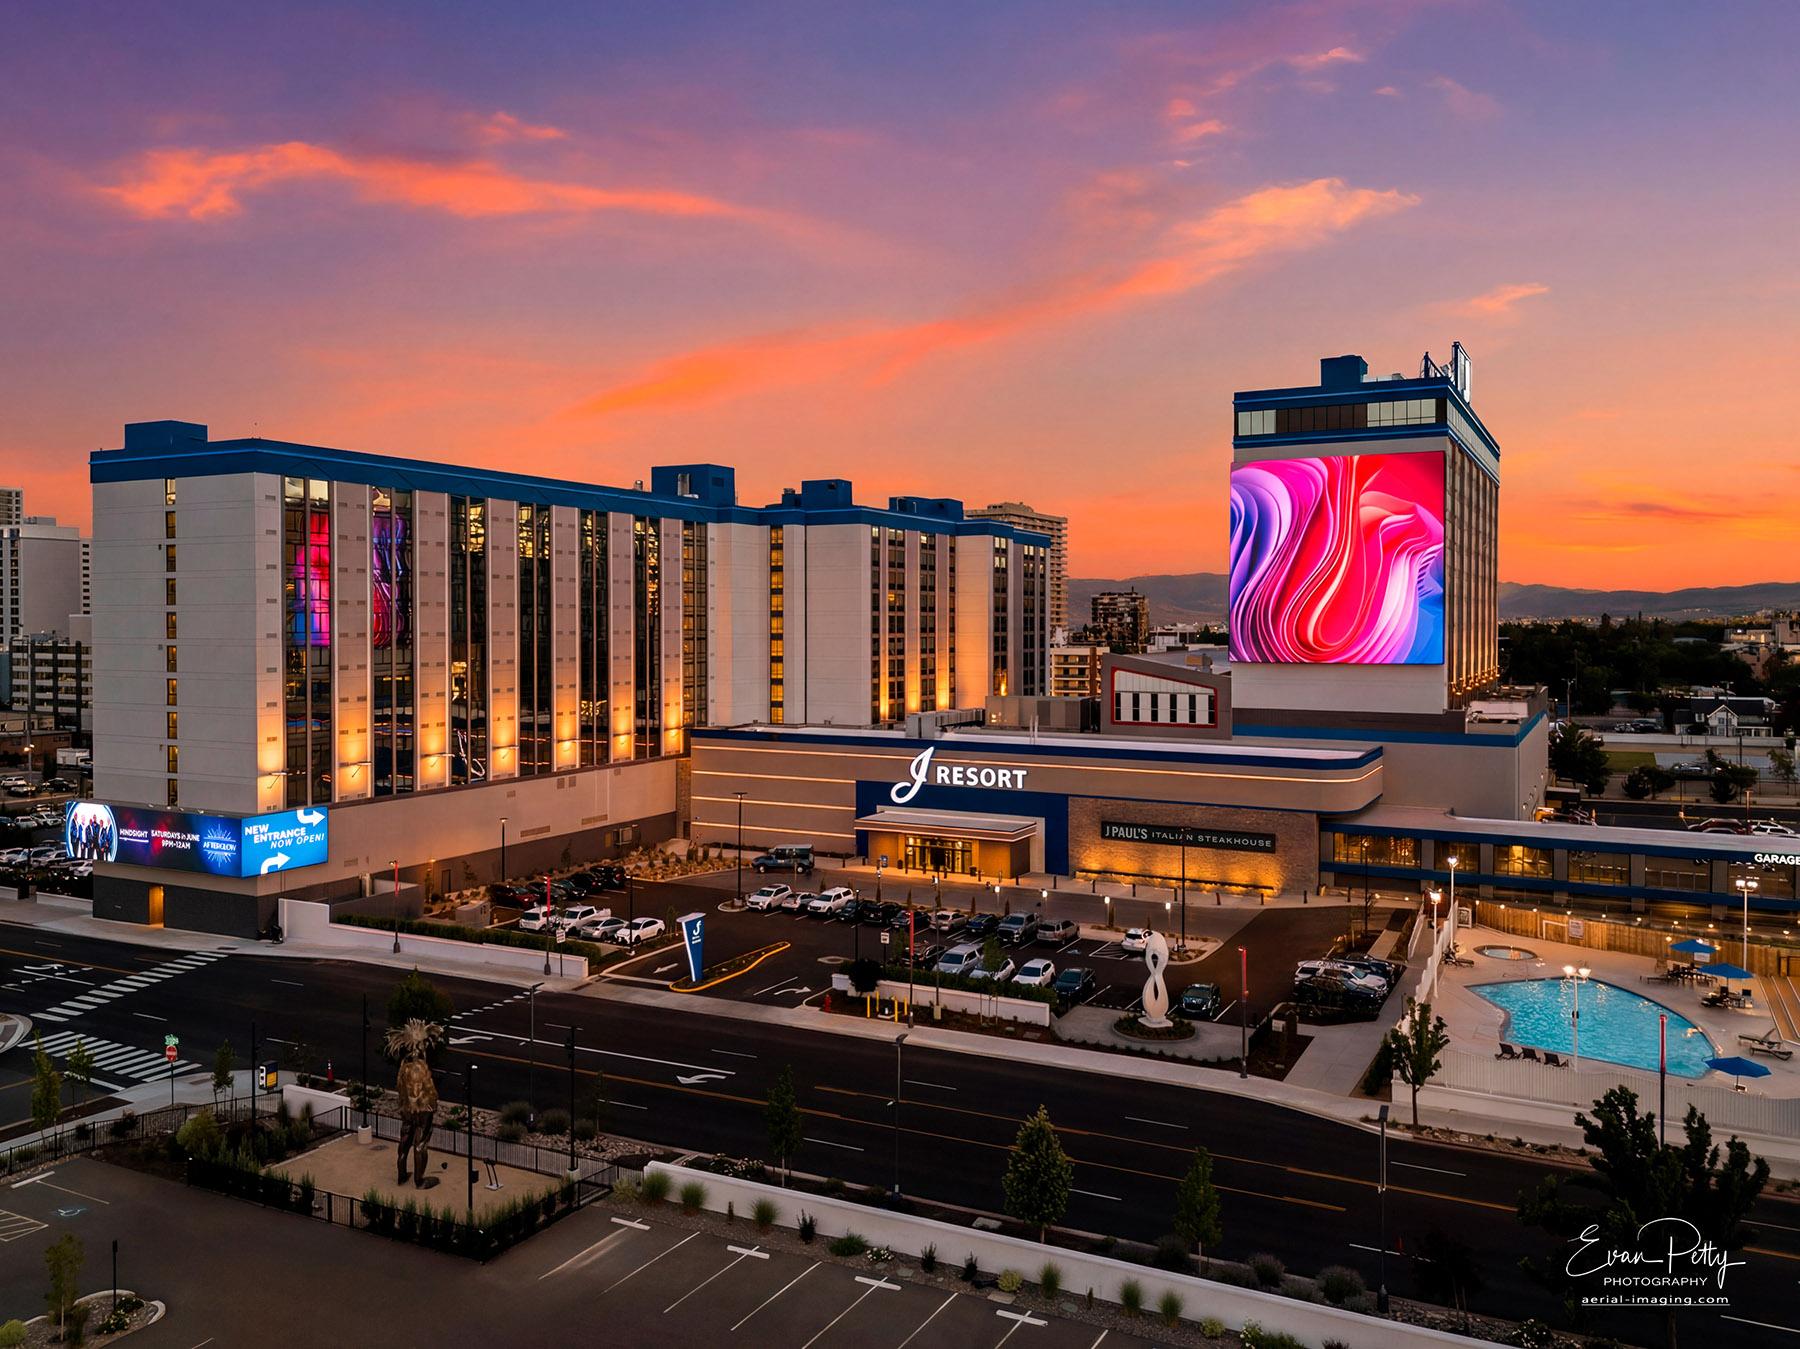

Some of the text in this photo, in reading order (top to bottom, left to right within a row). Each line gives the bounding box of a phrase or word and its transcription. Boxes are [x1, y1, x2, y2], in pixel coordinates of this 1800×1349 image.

[890, 746, 1027, 804] J RESORT
[119, 828, 149, 838] HINDSIGHT
[151, 829, 180, 840] SATURDAYS
[186, 833, 200, 842] JUNE
[244, 823, 269, 836] NEW
[253, 827, 306, 844] ENTRANCE
[270, 833, 325, 849] NOW OPEN!
[1105, 825, 1110, 837] J
[1112, 826, 1148, 840] PAUL'S
[1197, 835, 1272, 848] STEAKHOUSE
[202, 841, 237, 851] AFTERGLOW
[1754, 853, 1800, 866] GARAGE
